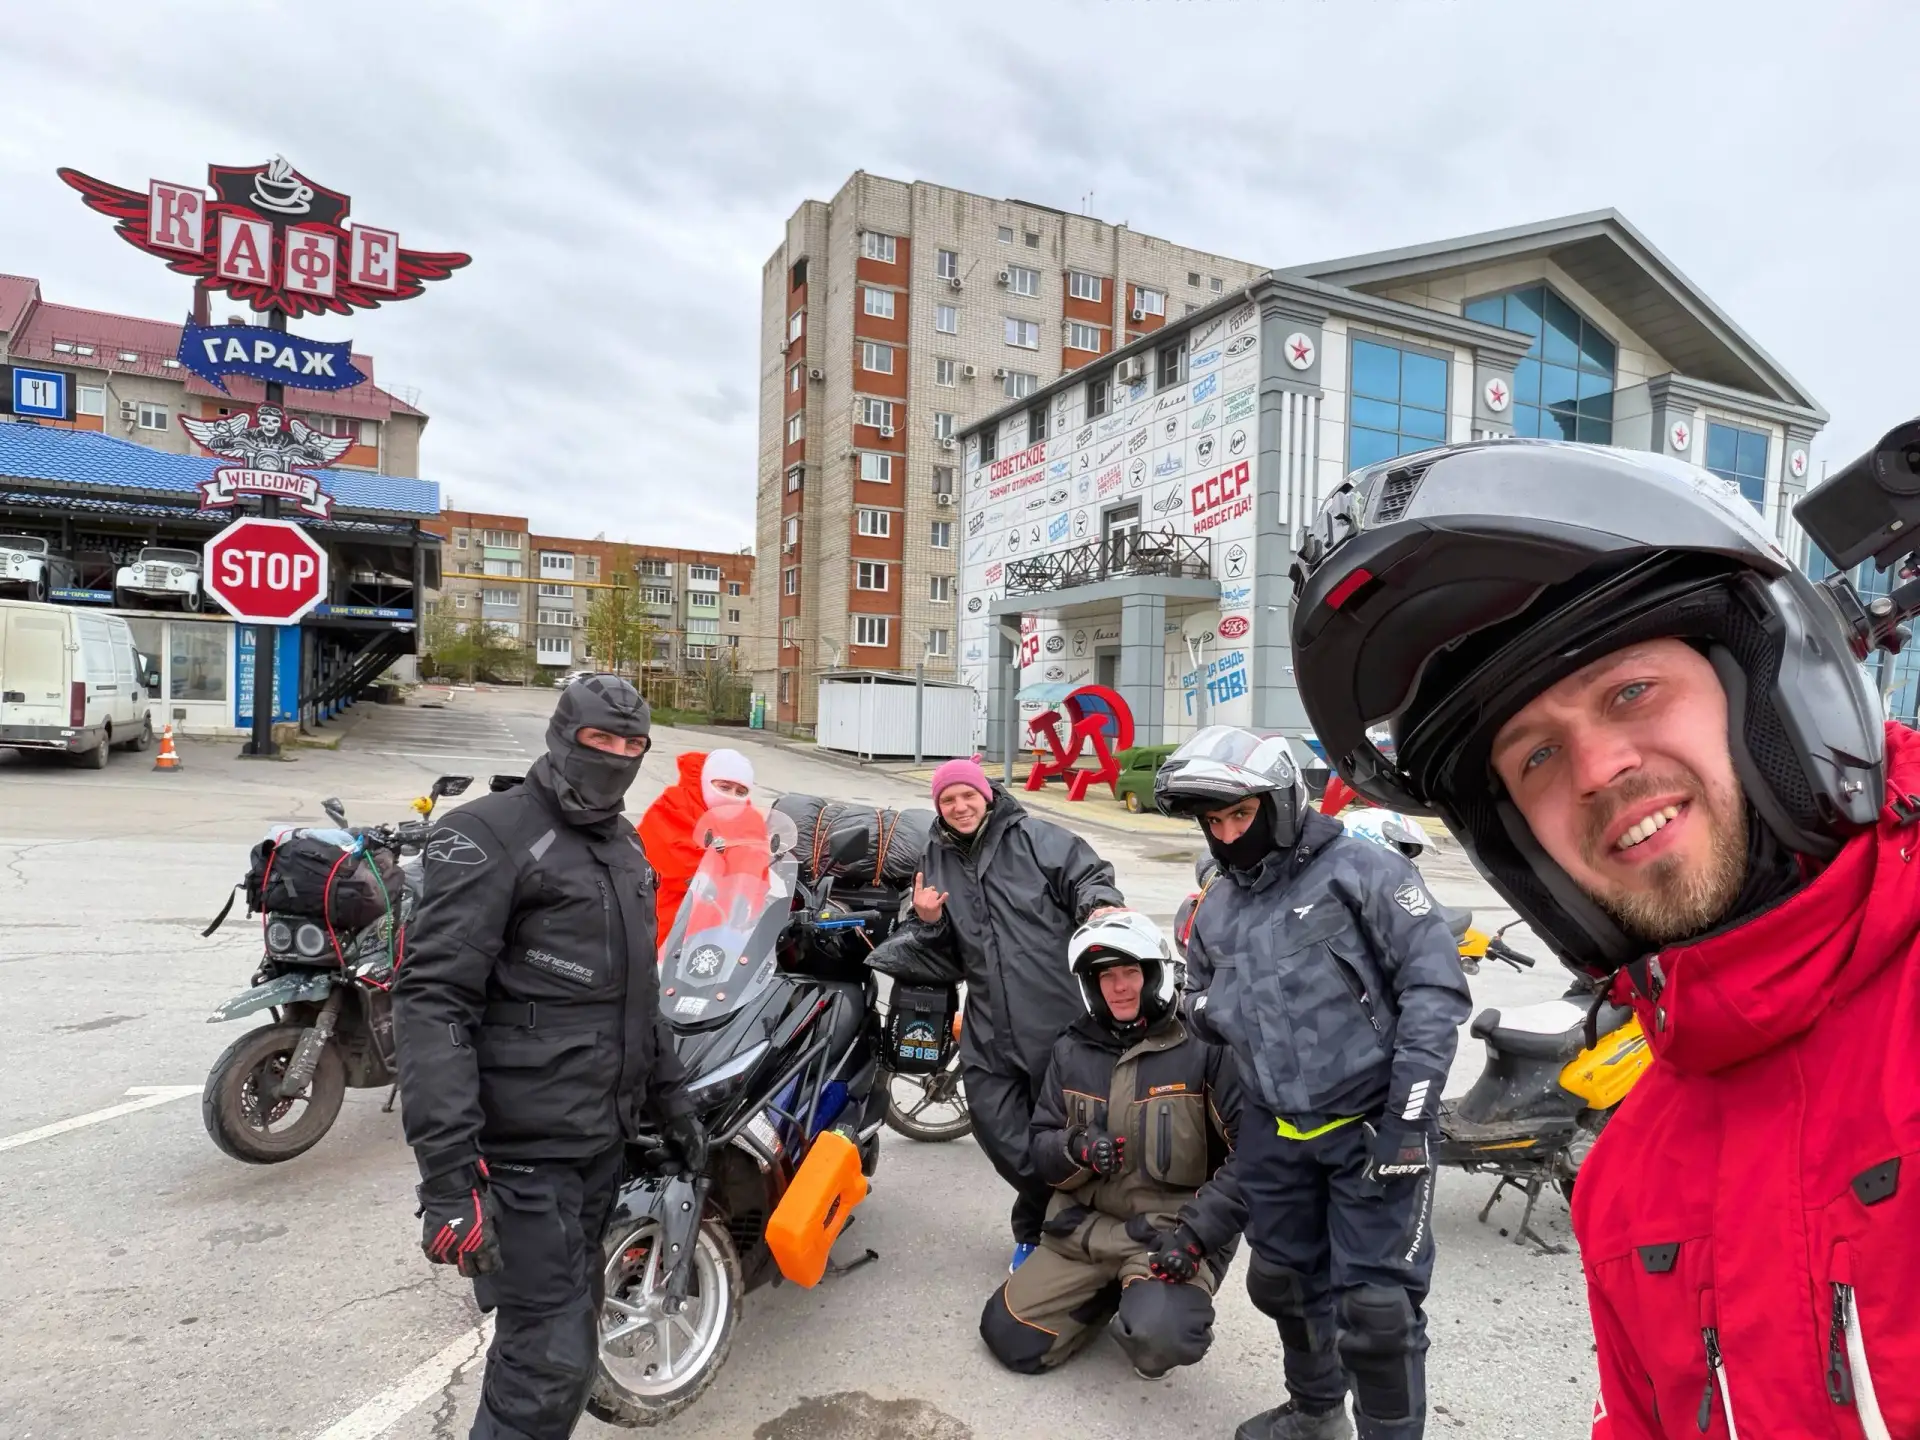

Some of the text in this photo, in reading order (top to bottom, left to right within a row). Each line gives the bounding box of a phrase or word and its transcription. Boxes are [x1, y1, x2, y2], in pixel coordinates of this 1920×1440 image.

[156, 188, 388, 289] КАФЕ
[203, 338, 335, 377] ГАРАЖ
[991, 444, 1046, 481] СОВЕТСКОЕ
[226, 471, 309, 495] WELCOME
[1191, 460, 1250, 517] СССР
[1194, 494, 1252, 535] НАВСЕГДА!
[221, 548, 315, 591] STOP
[1218, 650, 1244, 672] БУДЬ
[1185, 668, 1248, 716] ГТОВ!
[524, 956, 592, 983] TECH TOURING
[526, 948, 594, 977] alpinestars
[899, 1045, 939, 1061] 318
[1405, 1175, 1432, 1263] FINNTRAIL
